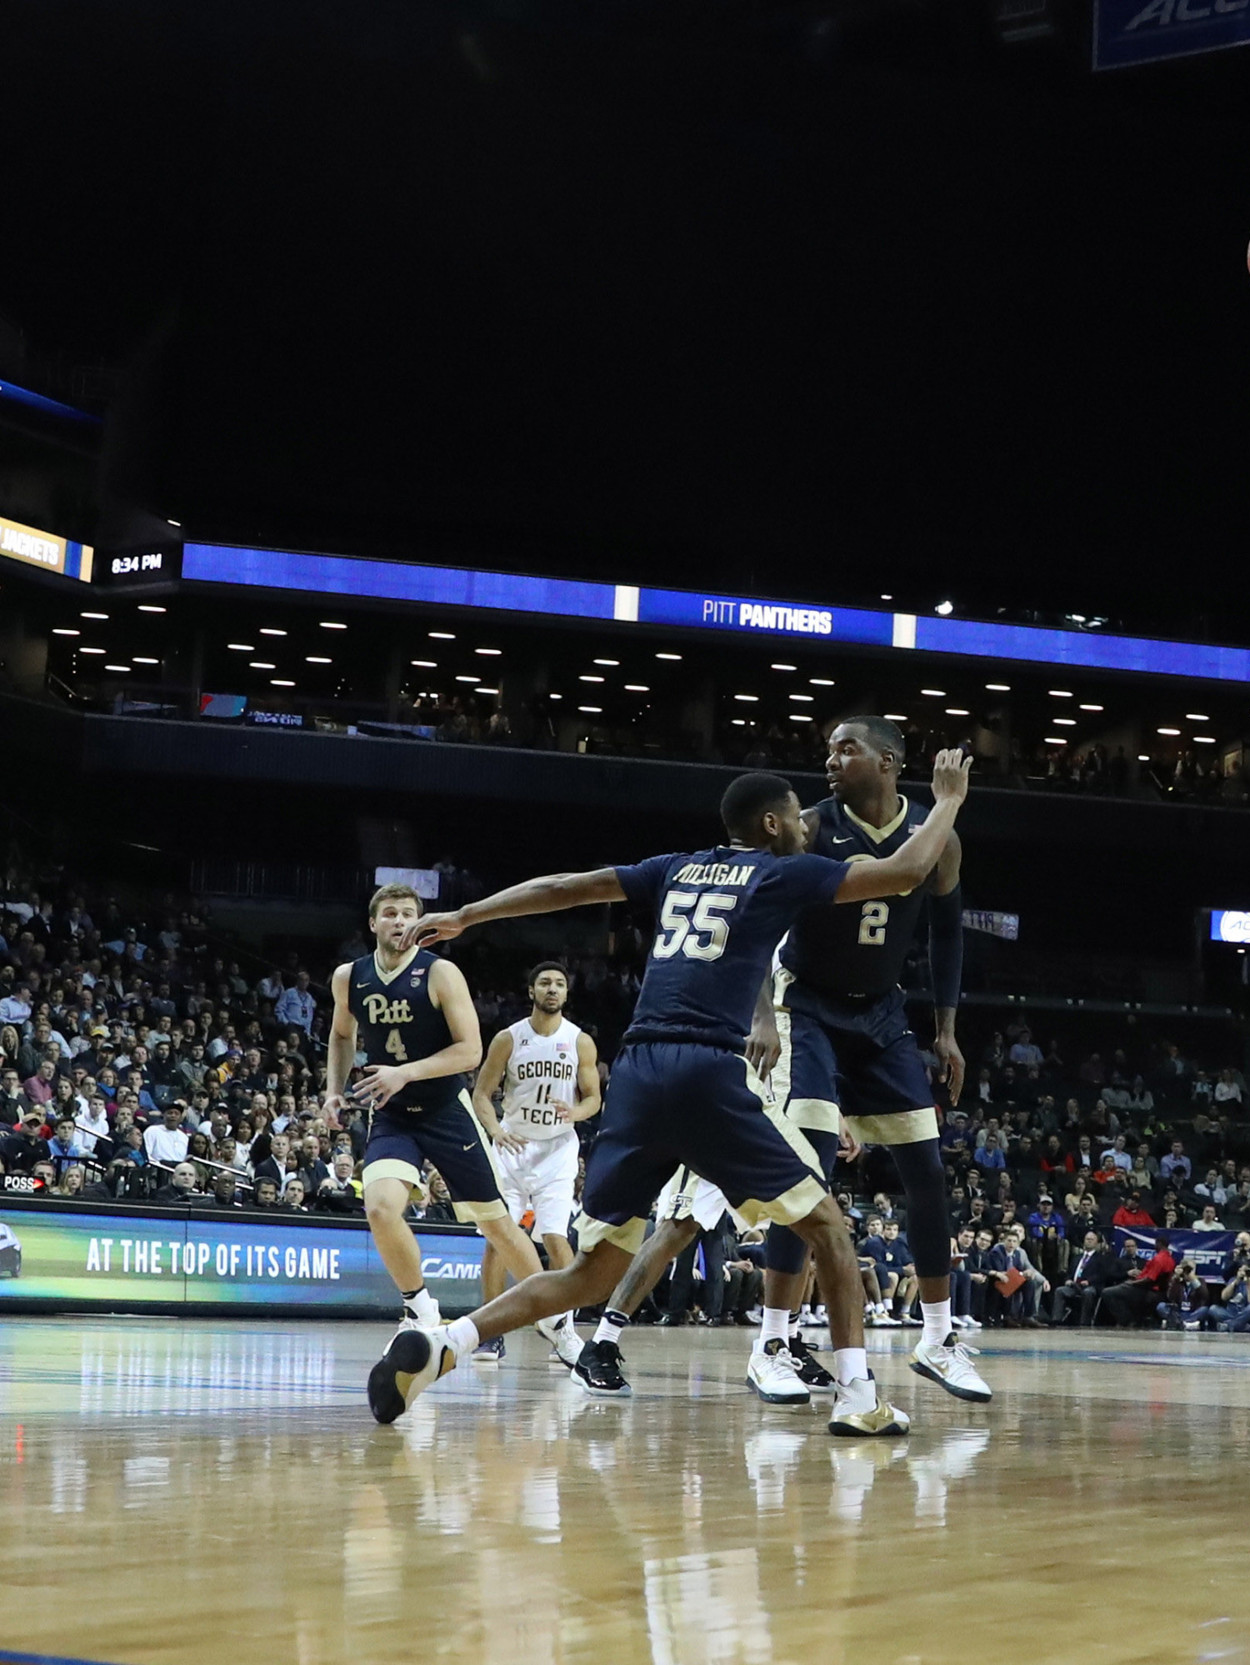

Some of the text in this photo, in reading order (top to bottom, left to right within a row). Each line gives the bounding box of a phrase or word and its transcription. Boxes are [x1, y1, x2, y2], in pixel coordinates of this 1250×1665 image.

[112, 553, 162, 574] 8:34 PM
[703, 599, 832, 634] PITT PANTHERS
[653, 890, 738, 962] 55
[857, 900, 890, 946] 2
[362, 993, 414, 1025] Pitt
[385, 1028, 408, 1061] 4
[517, 1060, 573, 1081] GEORGIA
[536, 1083, 552, 1105] 11
[521, 1107, 563, 1126] TECH
[4, 1175, 35, 1190] POSS
[86, 1238, 341, 1279] AT THE TOP OF ITS GAME
